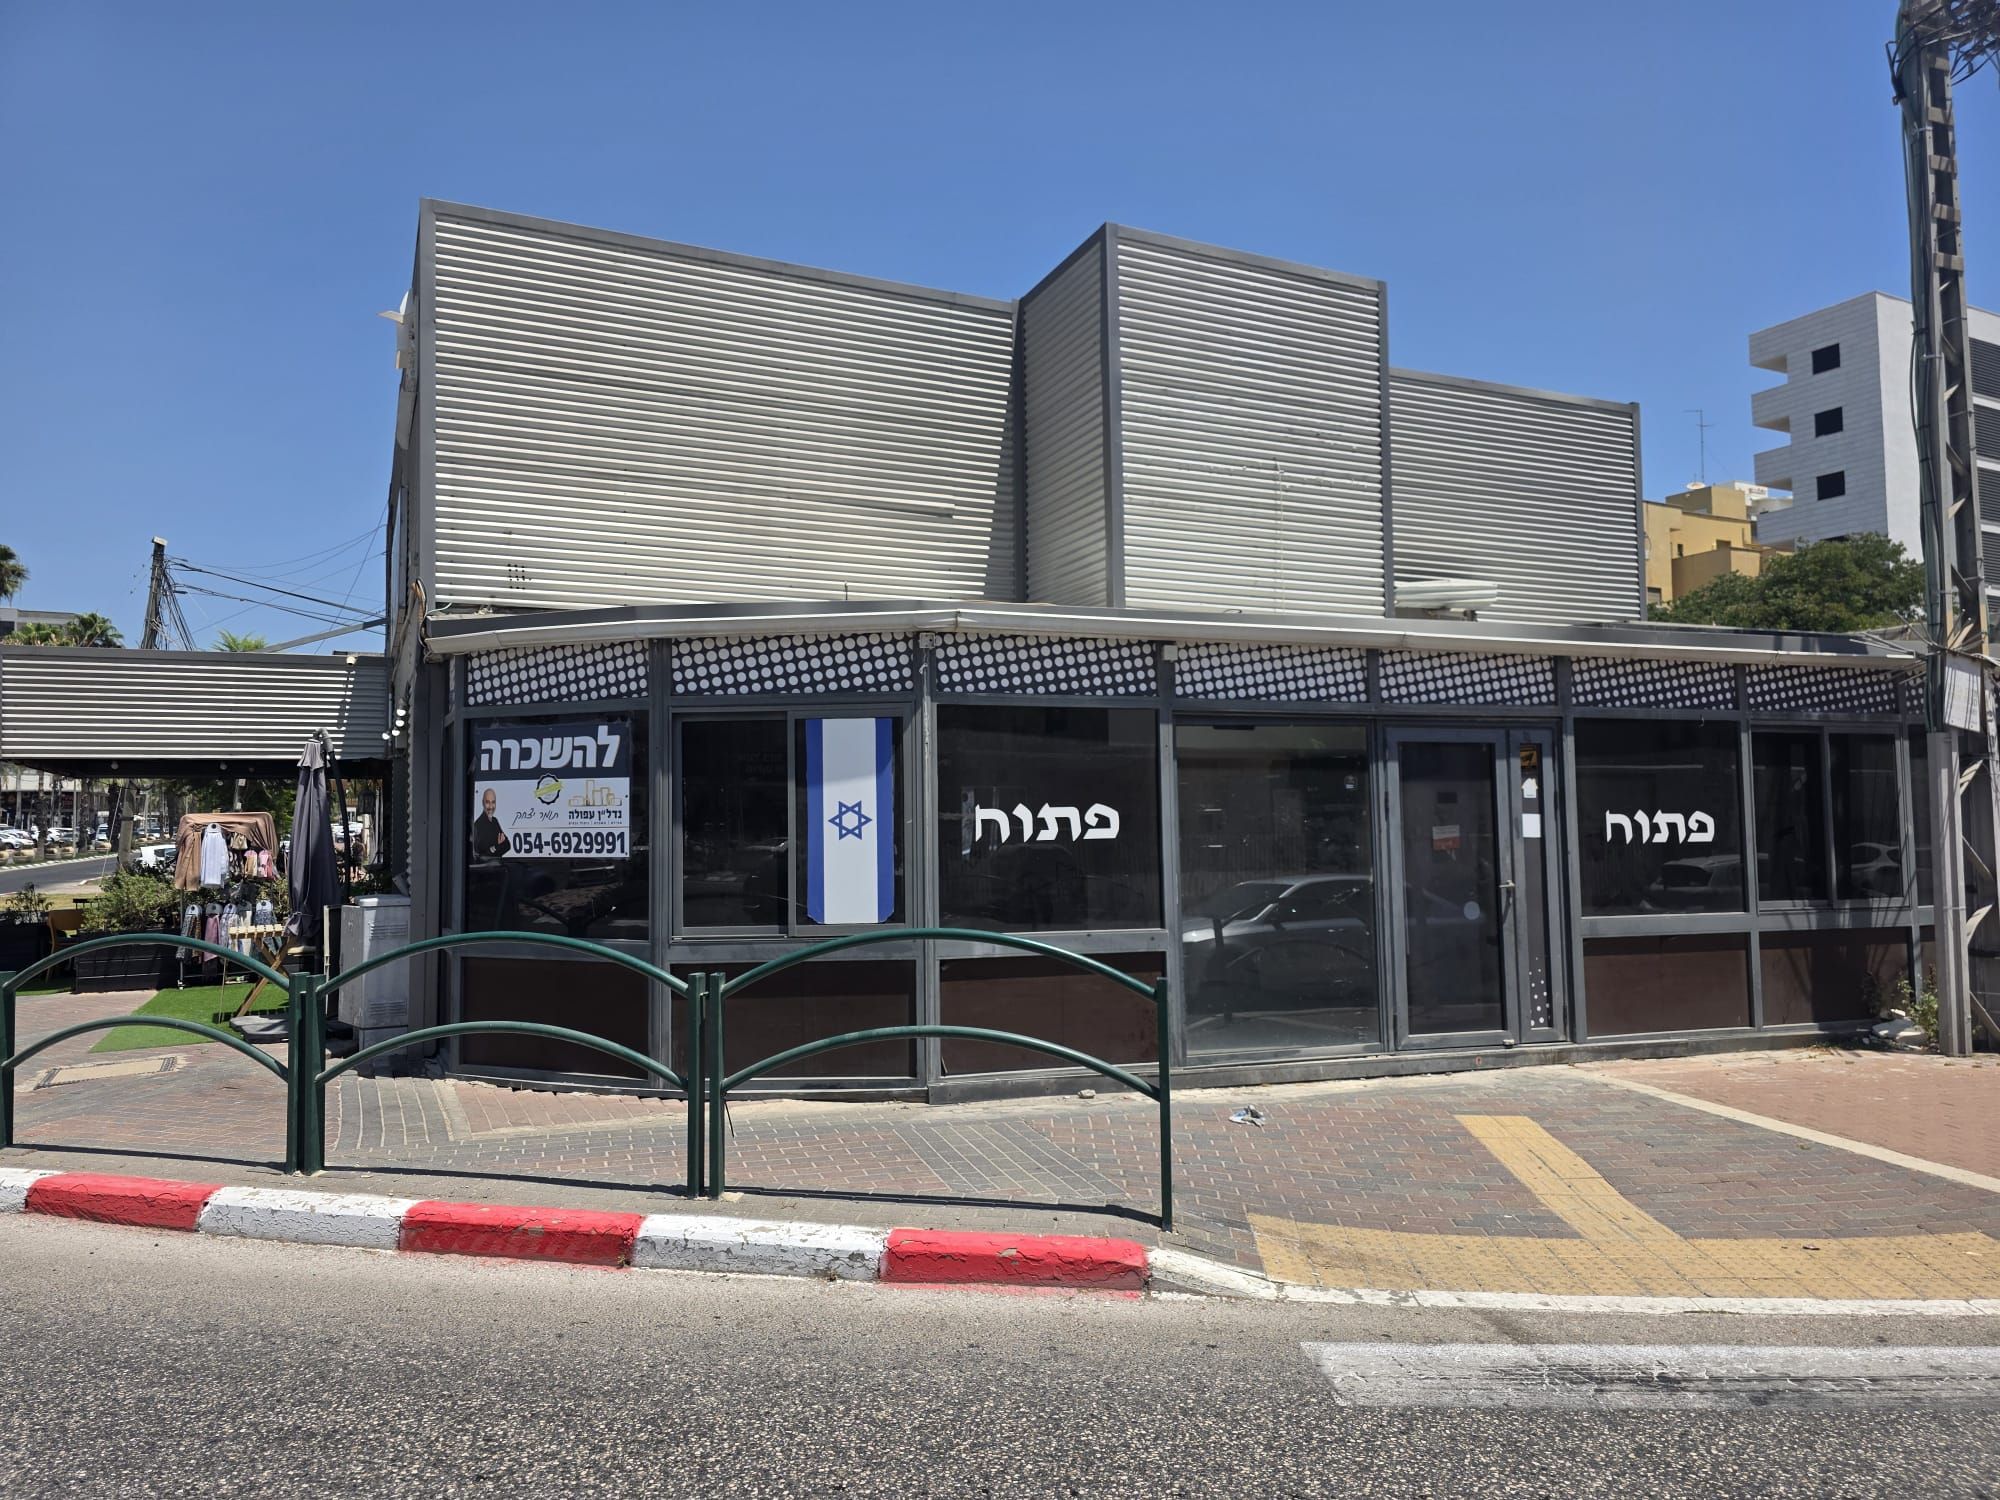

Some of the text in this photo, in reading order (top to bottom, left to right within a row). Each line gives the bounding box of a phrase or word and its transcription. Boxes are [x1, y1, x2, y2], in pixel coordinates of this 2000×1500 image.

[480, 725, 621, 771] להשכרה
[568, 808, 595, 820] עפולה
[975, 802, 1120, 844] פתוח
[1605, 809, 1715, 845] פתוח
[512, 831, 625, 855] 054-6929991
